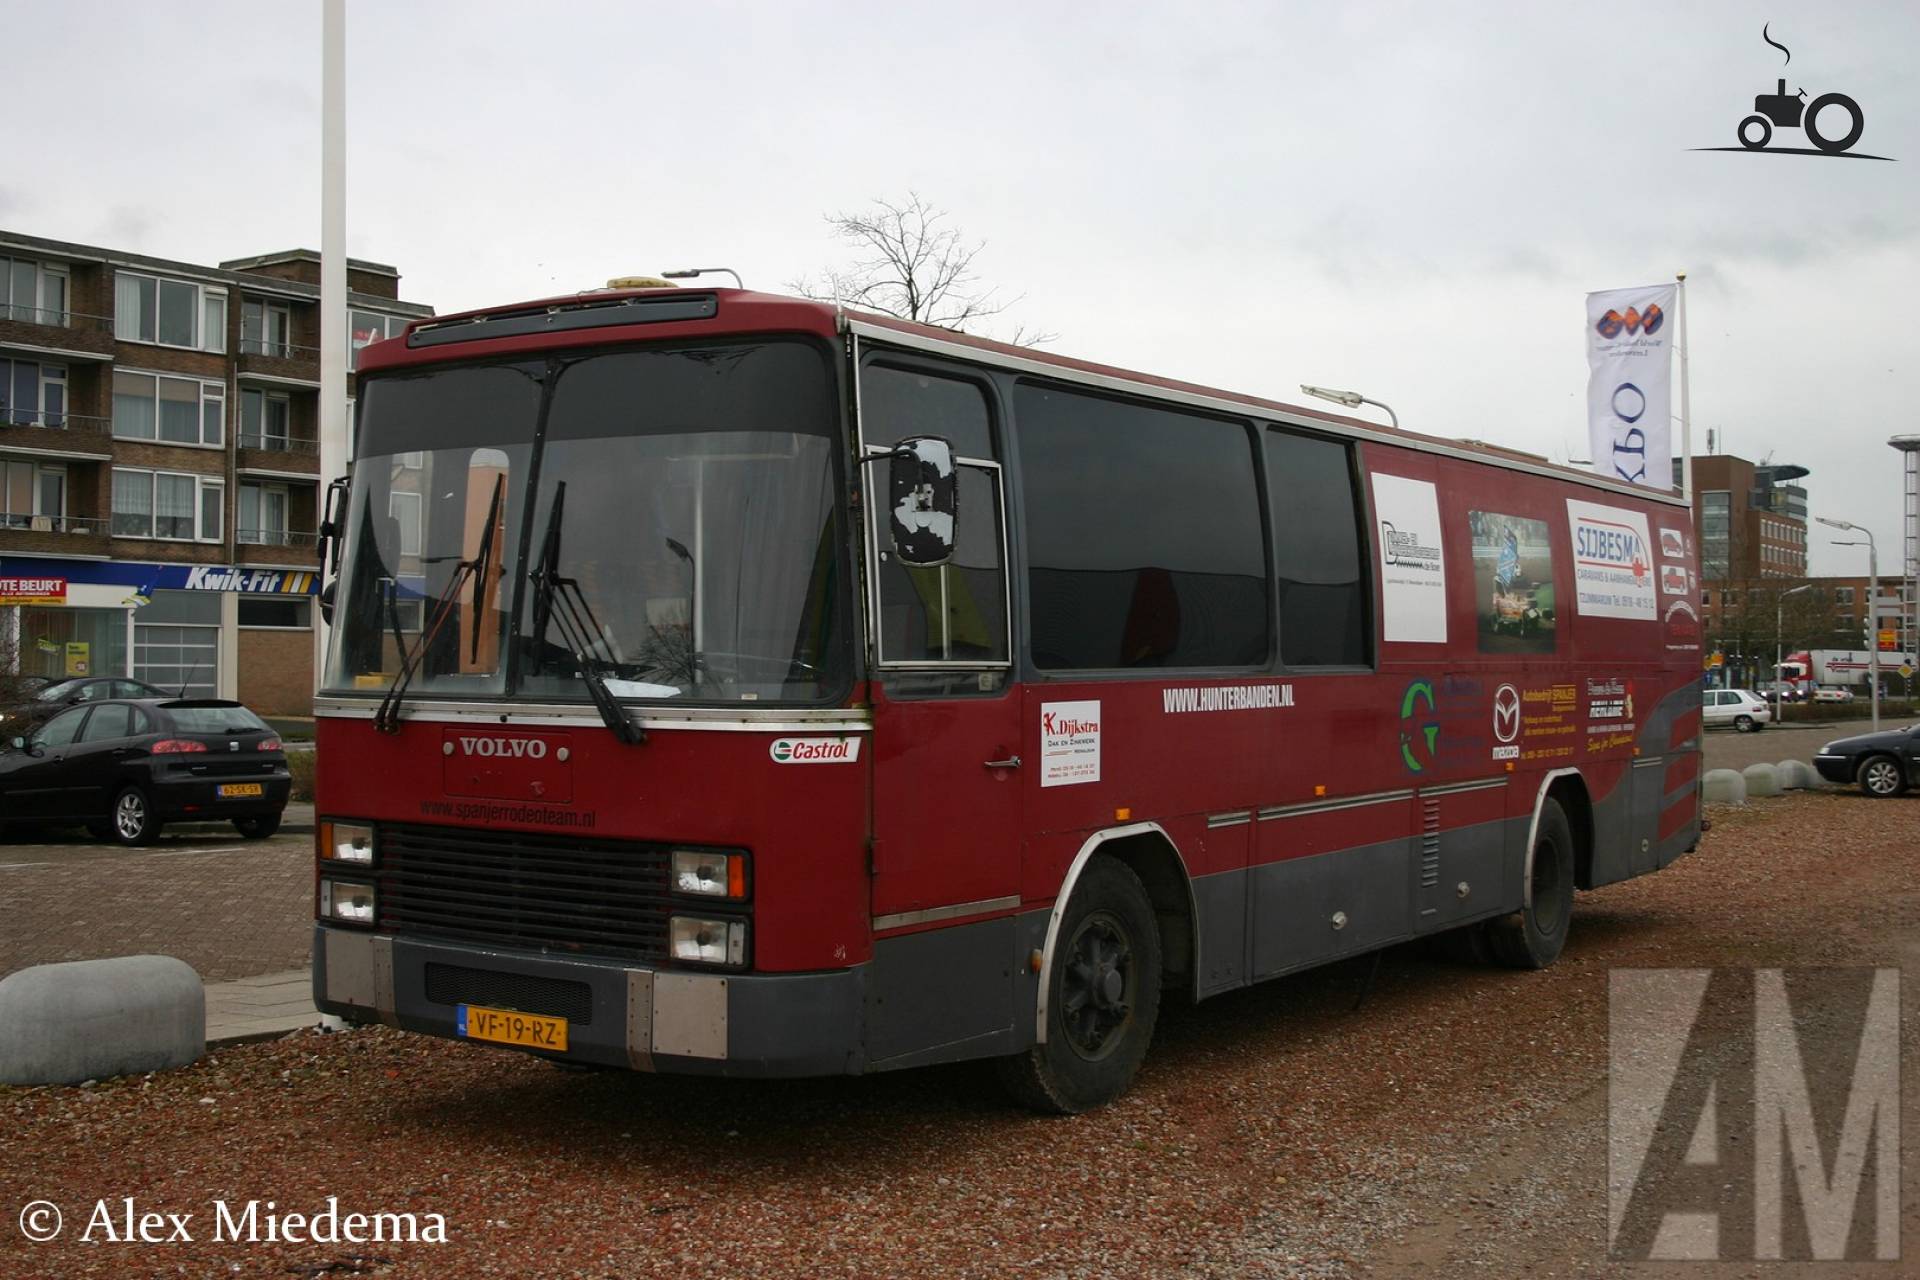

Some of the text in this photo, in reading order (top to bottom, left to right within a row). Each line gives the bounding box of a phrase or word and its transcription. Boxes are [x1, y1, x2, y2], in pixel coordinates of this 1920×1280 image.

[0, 579, 64, 592] TE BEURT
[184, 566, 281, 593] Kwik-Fit
[1163, 684, 1295, 713] WWW.HUNTERBANDEN.NL
[459, 736, 547, 759] VOLVO
[792, 741, 849, 759] Castrol
[419, 800, 597, 829] www.spanjerrodeoteam.nl
[475, 1011, 558, 1046] VF-19-RZ
